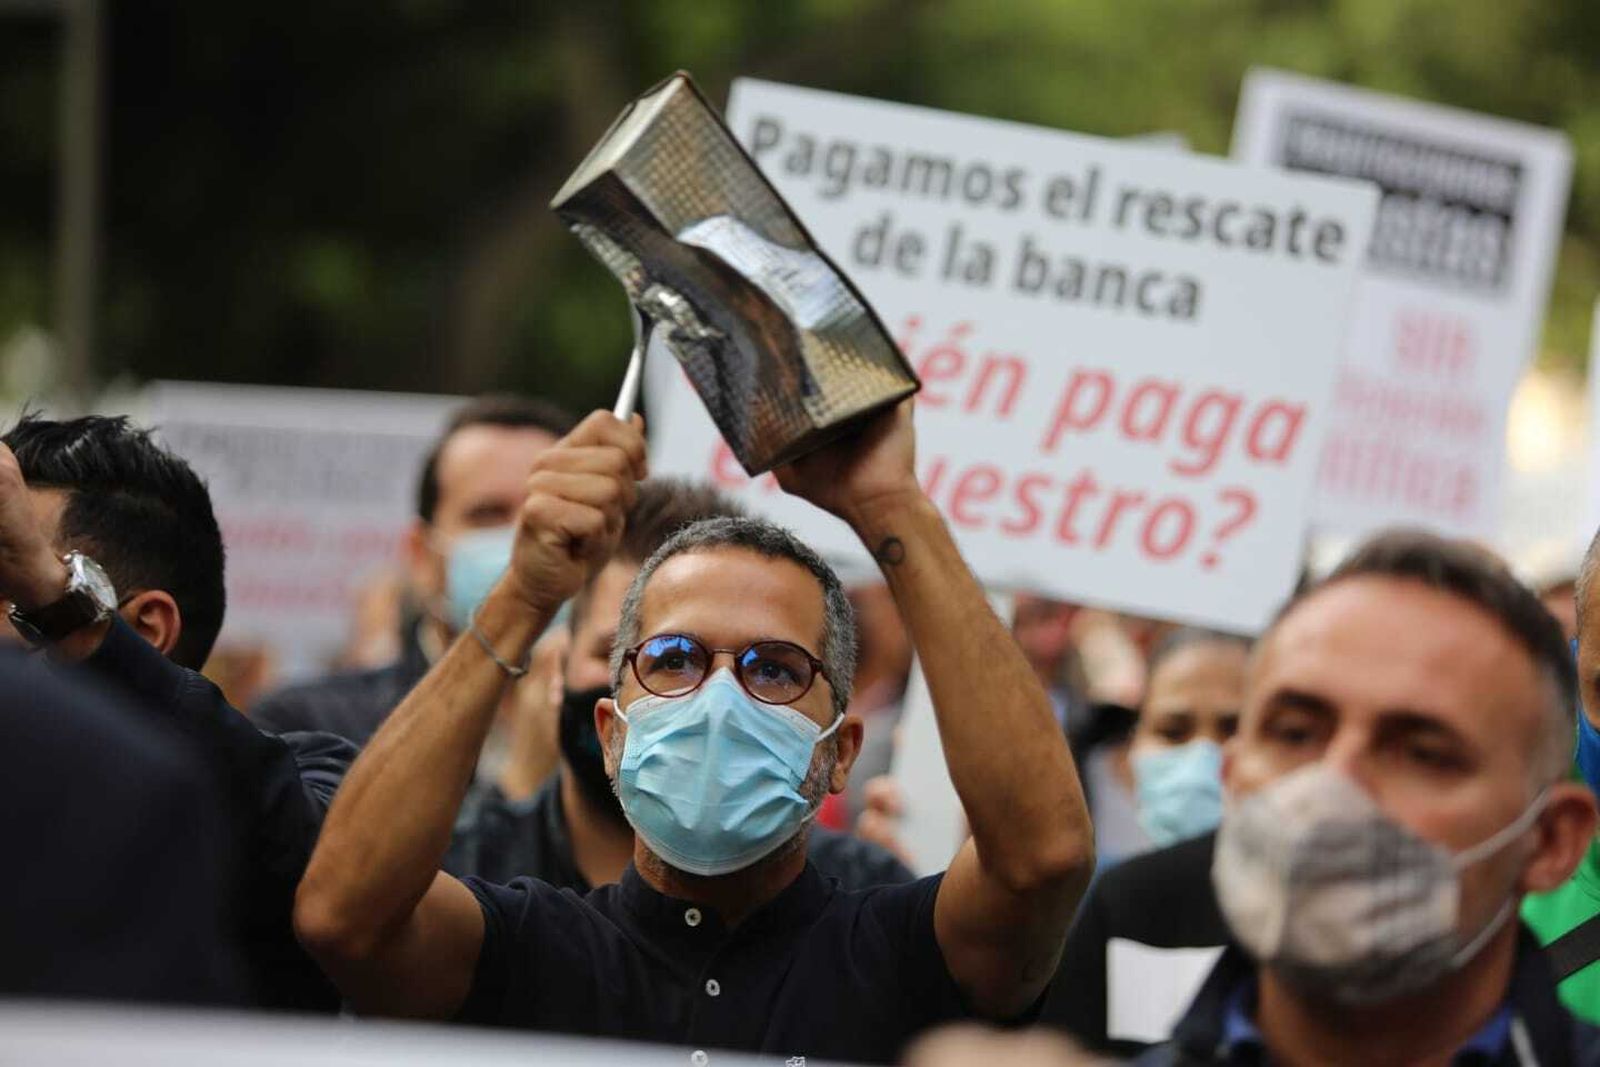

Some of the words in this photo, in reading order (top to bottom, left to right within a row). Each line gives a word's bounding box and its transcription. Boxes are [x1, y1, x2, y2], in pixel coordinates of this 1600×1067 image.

[749, 115, 1023, 211] Pagamos
[1044, 166, 1100, 223] el
[1113, 187, 1347, 264] rescate
[851, 214, 926, 276] de
[942, 225, 996, 286] la
[1015, 238, 1201, 320] banca
[1042, 368, 1307, 478] paga
[927, 454, 1260, 569] estro?
